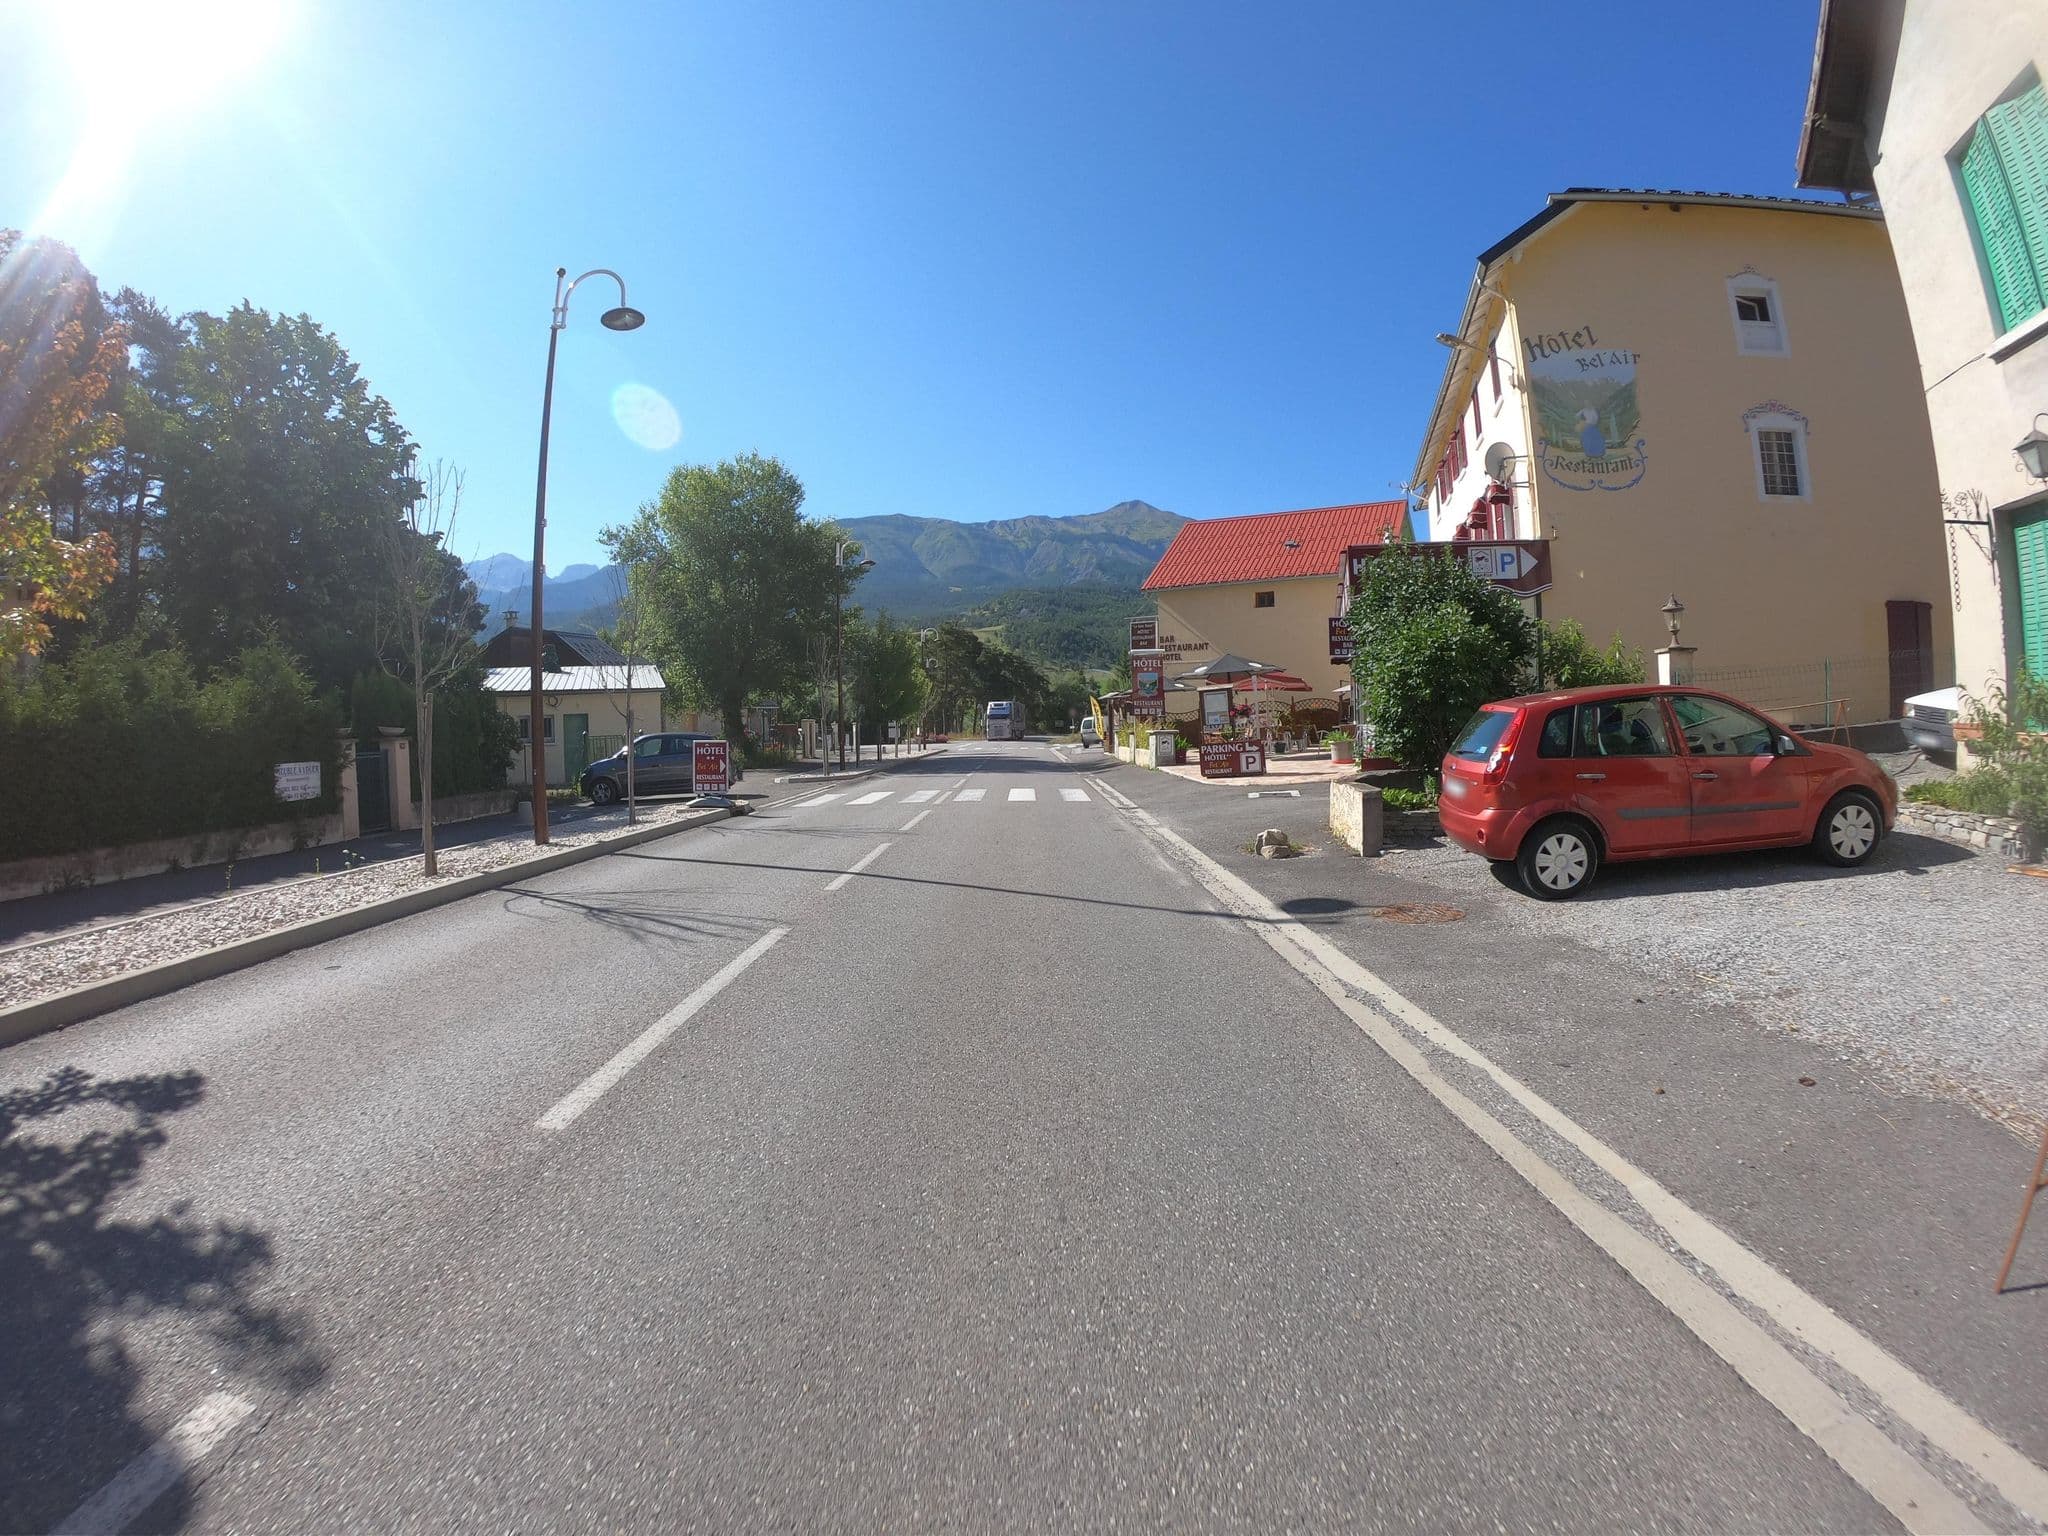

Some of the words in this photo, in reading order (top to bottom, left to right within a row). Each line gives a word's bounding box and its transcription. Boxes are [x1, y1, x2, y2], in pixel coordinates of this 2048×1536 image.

[1520, 325, 1599, 363] Hôtel
[1550, 455, 1636, 475] Restaurant
[1500, 553, 1515, 572] P
[1160, 635, 1175, 644] BAR
[696, 744, 725, 755] HÔTEL
[1201, 743, 1243, 753] PARKING
[1246, 756, 1256, 770] P
